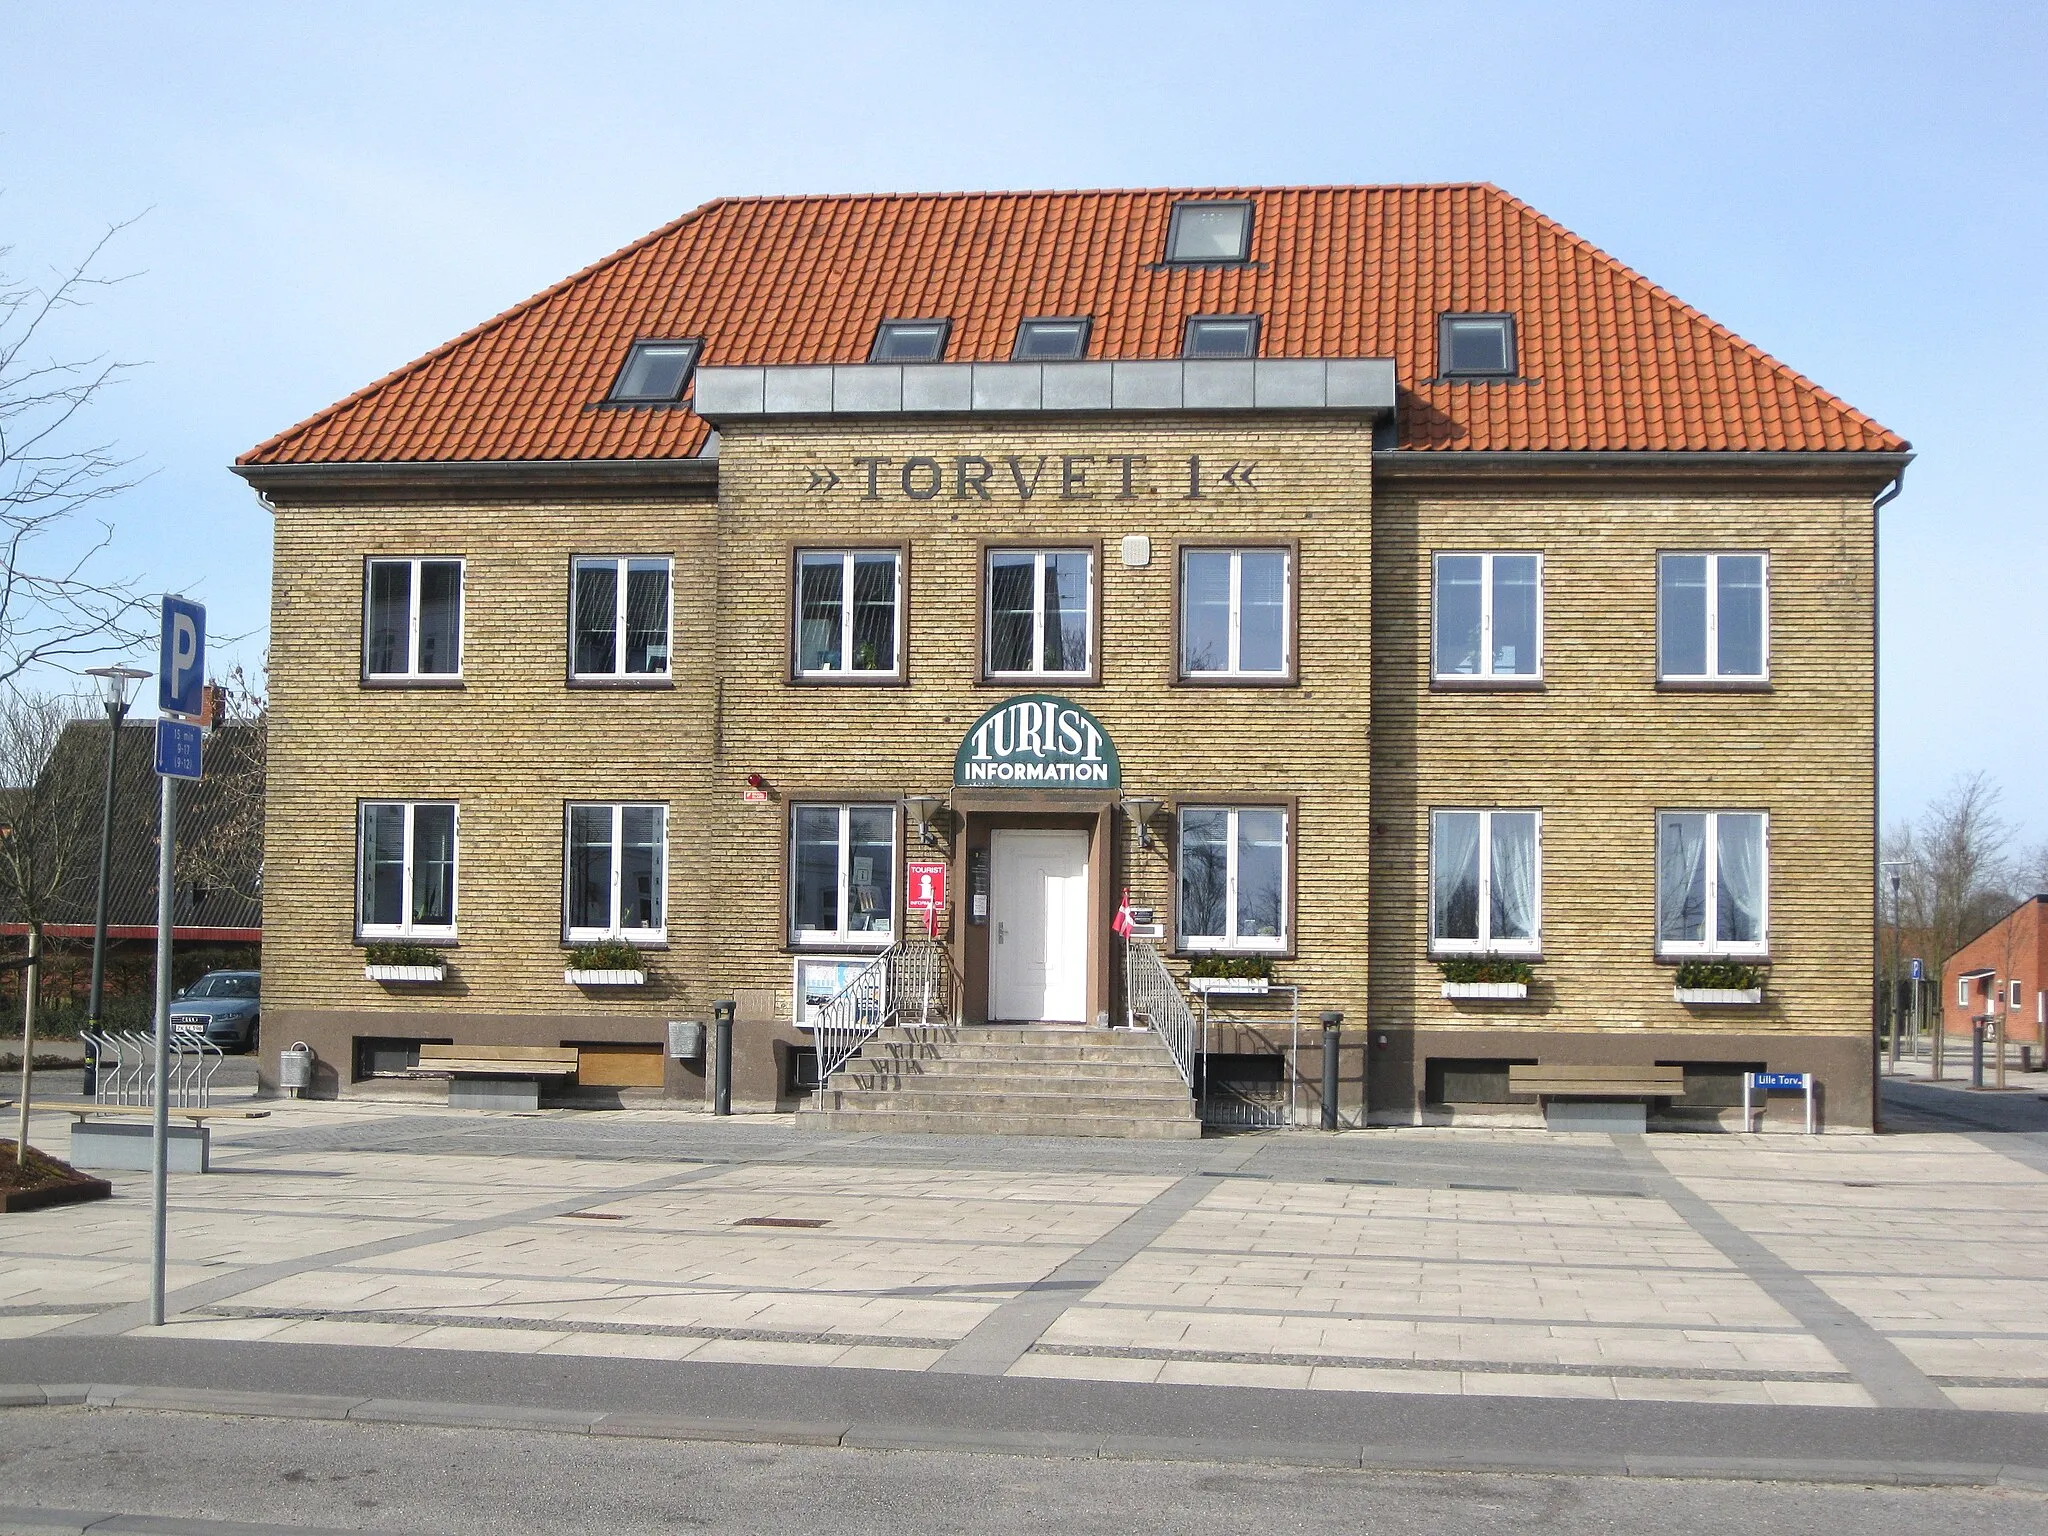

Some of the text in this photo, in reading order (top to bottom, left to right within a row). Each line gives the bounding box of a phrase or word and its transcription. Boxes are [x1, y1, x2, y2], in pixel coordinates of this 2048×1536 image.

[853, 454, 1207, 499] TORVET 1
[171, 612, 197, 699] P
[174, 728, 194, 742] 15 min
[971, 701, 1103, 761] TURIST
[964, 762, 1108, 781] INFORMATION
[911, 866, 943, 874] TOURIST
[1913, 960, 1919, 977] P
[1759, 1075, 1776, 1085] Lille
